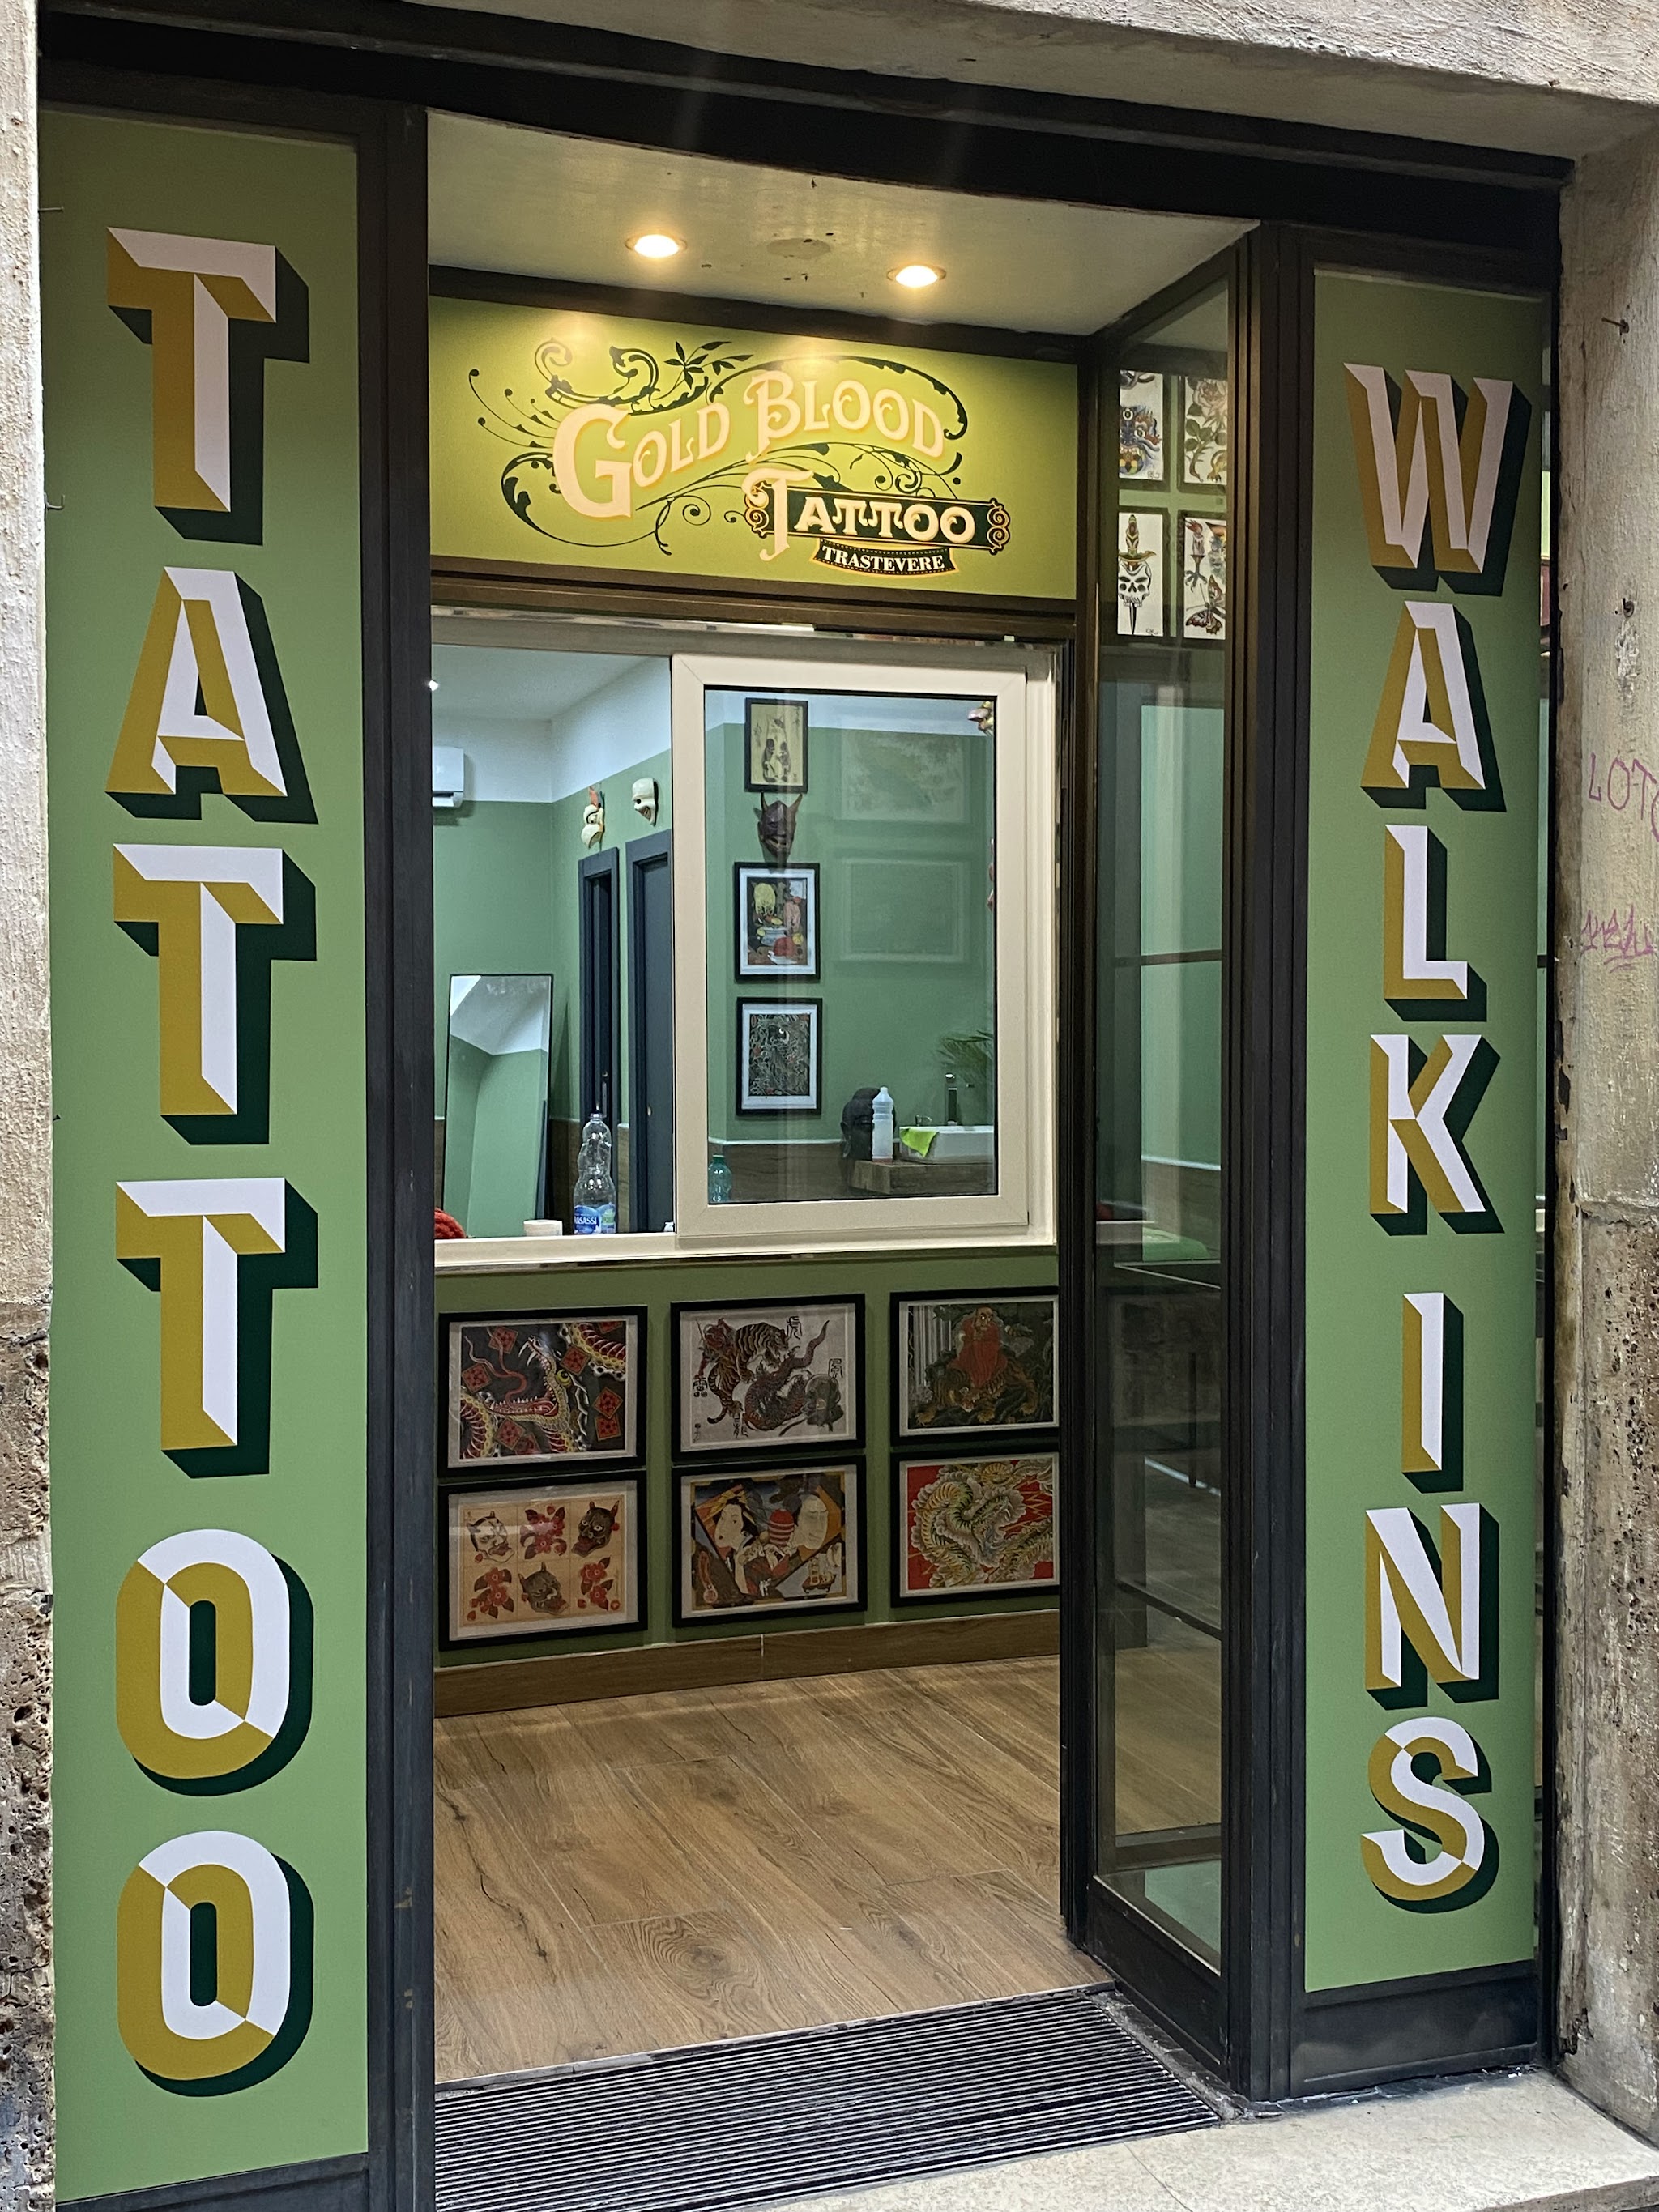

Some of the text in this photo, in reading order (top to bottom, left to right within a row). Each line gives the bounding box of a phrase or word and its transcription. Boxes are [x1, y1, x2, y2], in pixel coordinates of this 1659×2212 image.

[553, 370, 945, 518] GOLD BLOOD
[741, 467, 976, 561] TATTOO
[821, 544, 945, 572] TRASTEVERE
[106, 227, 318, 2096] TATTOO
